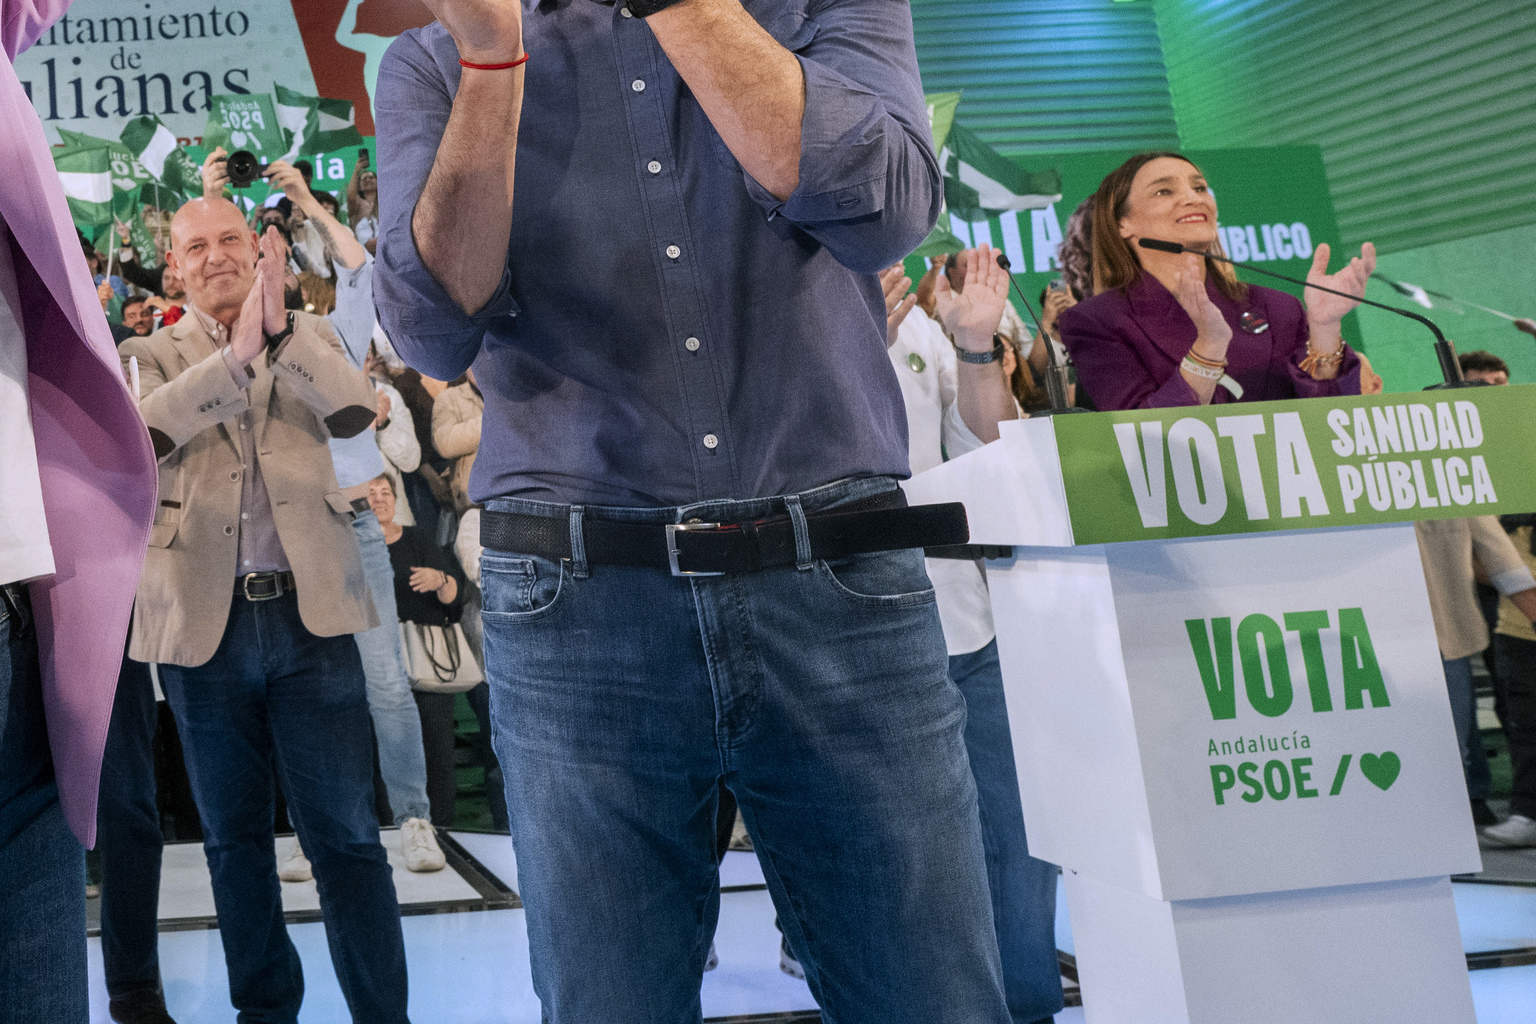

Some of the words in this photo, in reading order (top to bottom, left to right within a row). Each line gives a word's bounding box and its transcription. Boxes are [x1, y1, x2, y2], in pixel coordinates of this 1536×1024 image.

[110, 46, 142, 70] de
[1326, 400, 1484, 457] SANIDAD
[1112, 411, 1330, 528] VOTA
[1336, 454, 1498, 514] PÚBLICA
[1184, 607, 1391, 721] VOTA
[1207, 730, 1311, 757] Andalucía
[1209, 757, 1319, 806] PSOE
